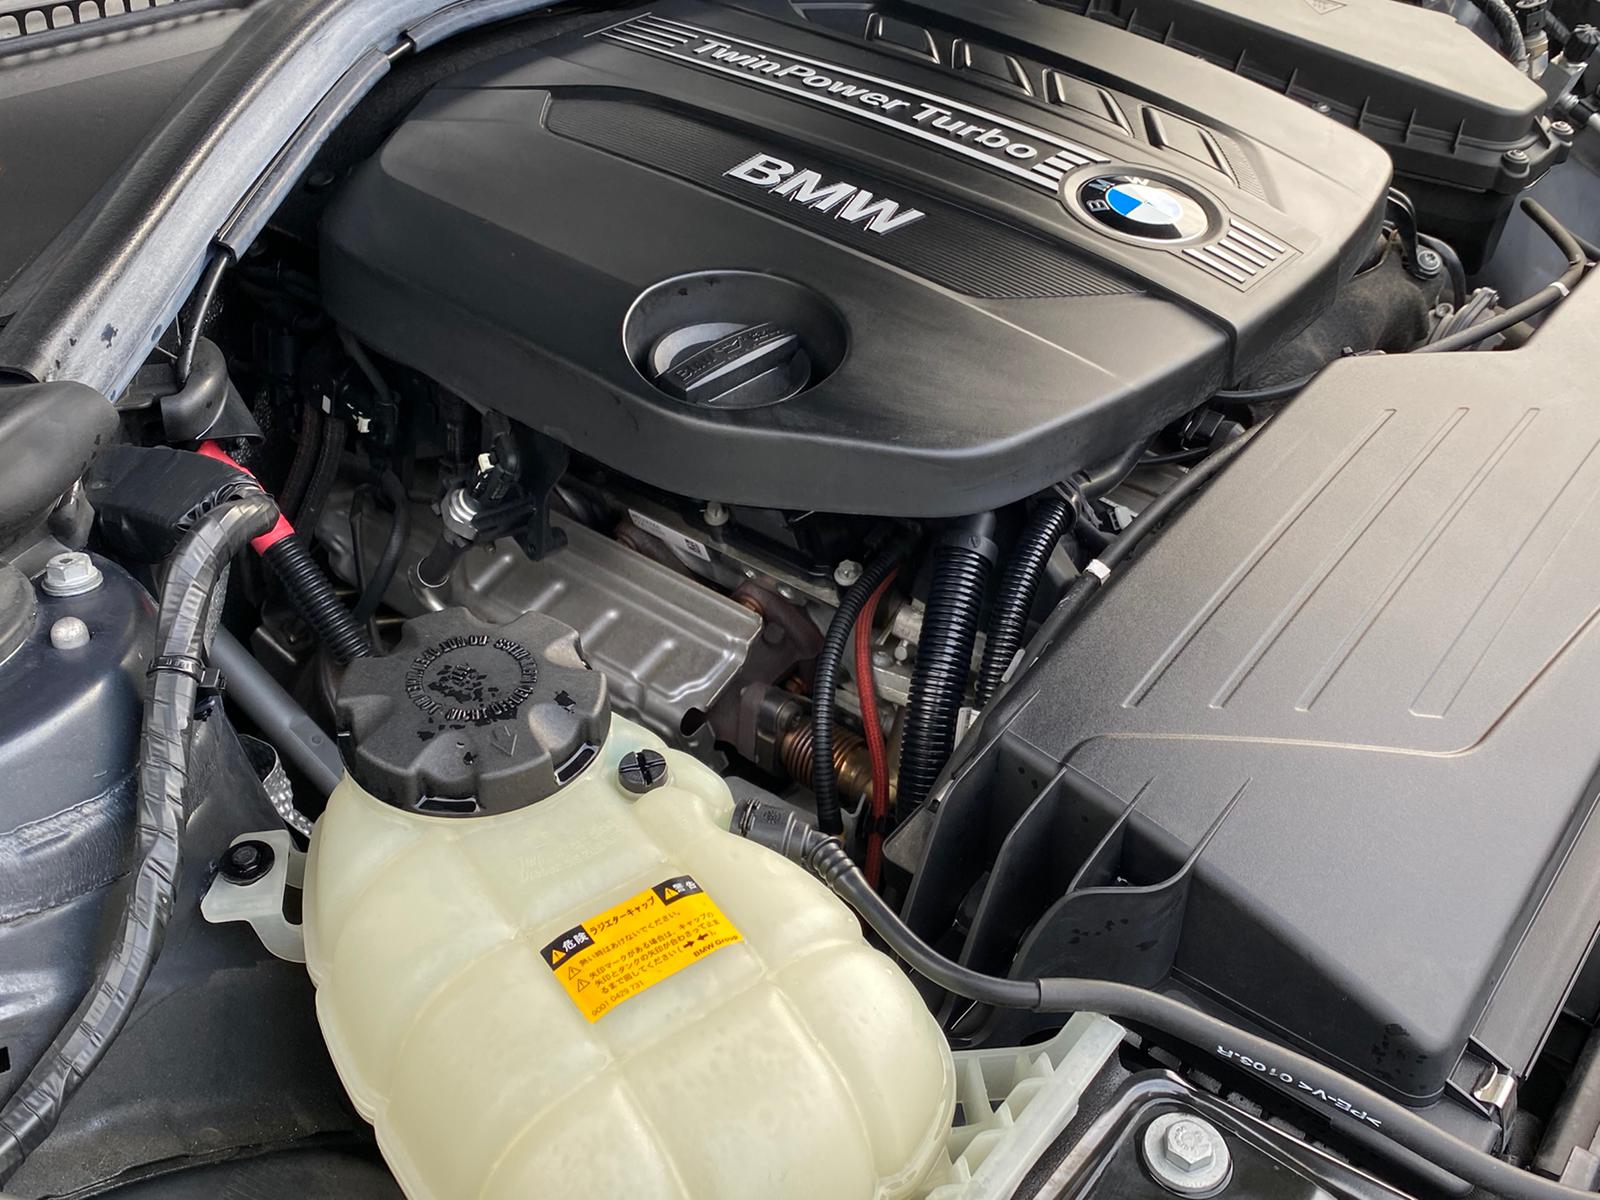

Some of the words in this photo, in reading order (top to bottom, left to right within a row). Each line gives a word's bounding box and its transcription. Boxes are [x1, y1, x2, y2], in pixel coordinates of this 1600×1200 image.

[693, 38, 911, 111] TwinPower
[912, 103, 1038, 159] Turbo
[722, 152, 926, 236] BMW
[562, 931, 590, 953] 危険
[693, 943, 714, 957] BMW
